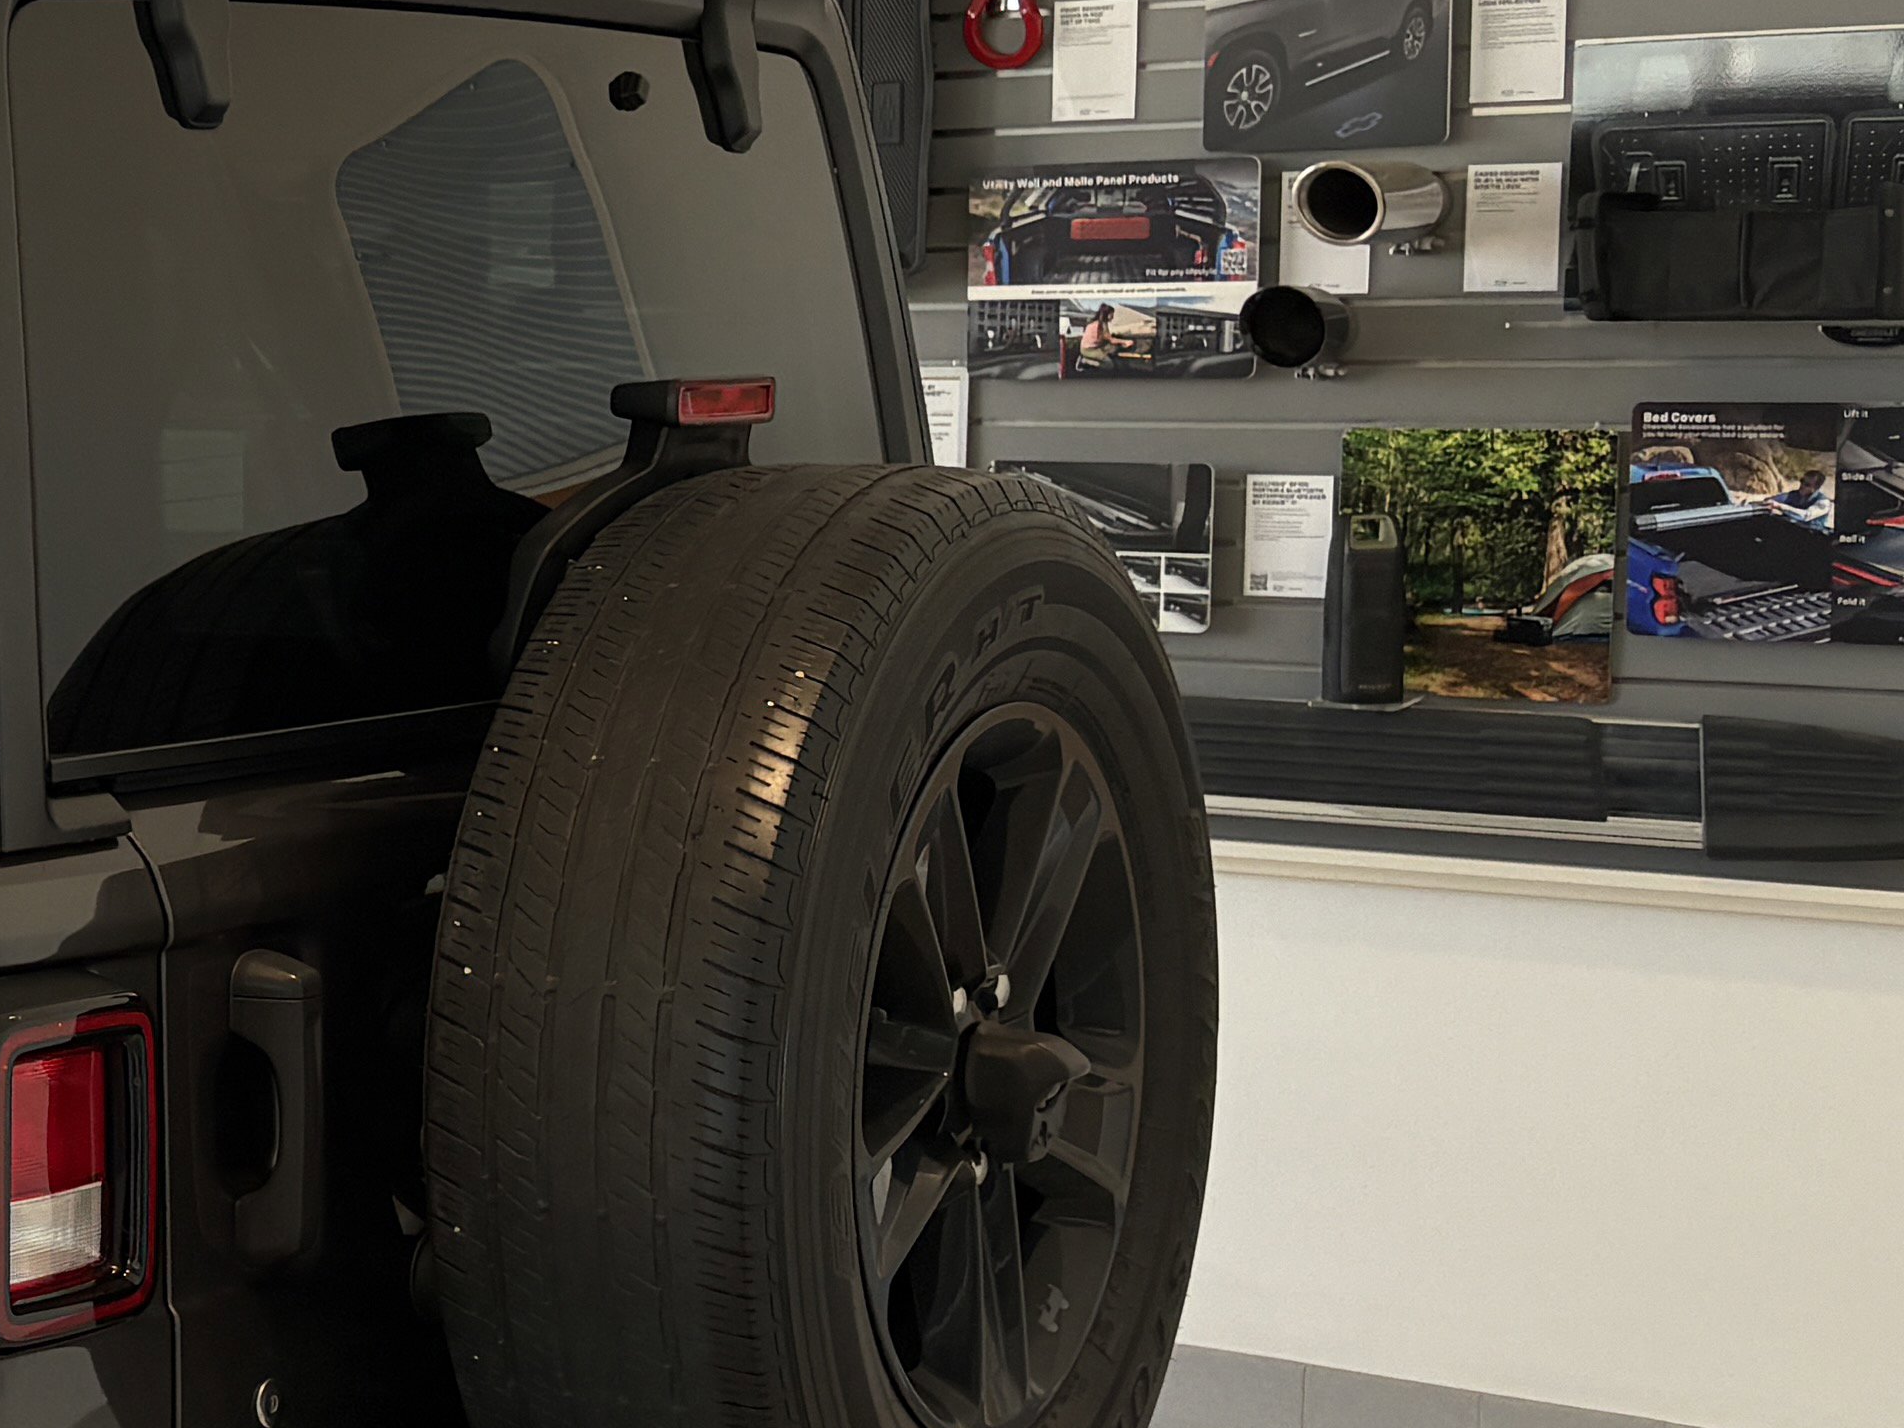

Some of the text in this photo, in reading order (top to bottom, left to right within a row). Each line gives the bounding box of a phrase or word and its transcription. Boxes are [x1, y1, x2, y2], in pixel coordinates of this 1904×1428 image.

[1096, 175, 1126, 186] Panel
[1643, 412, 1716, 423] Bed Covers
